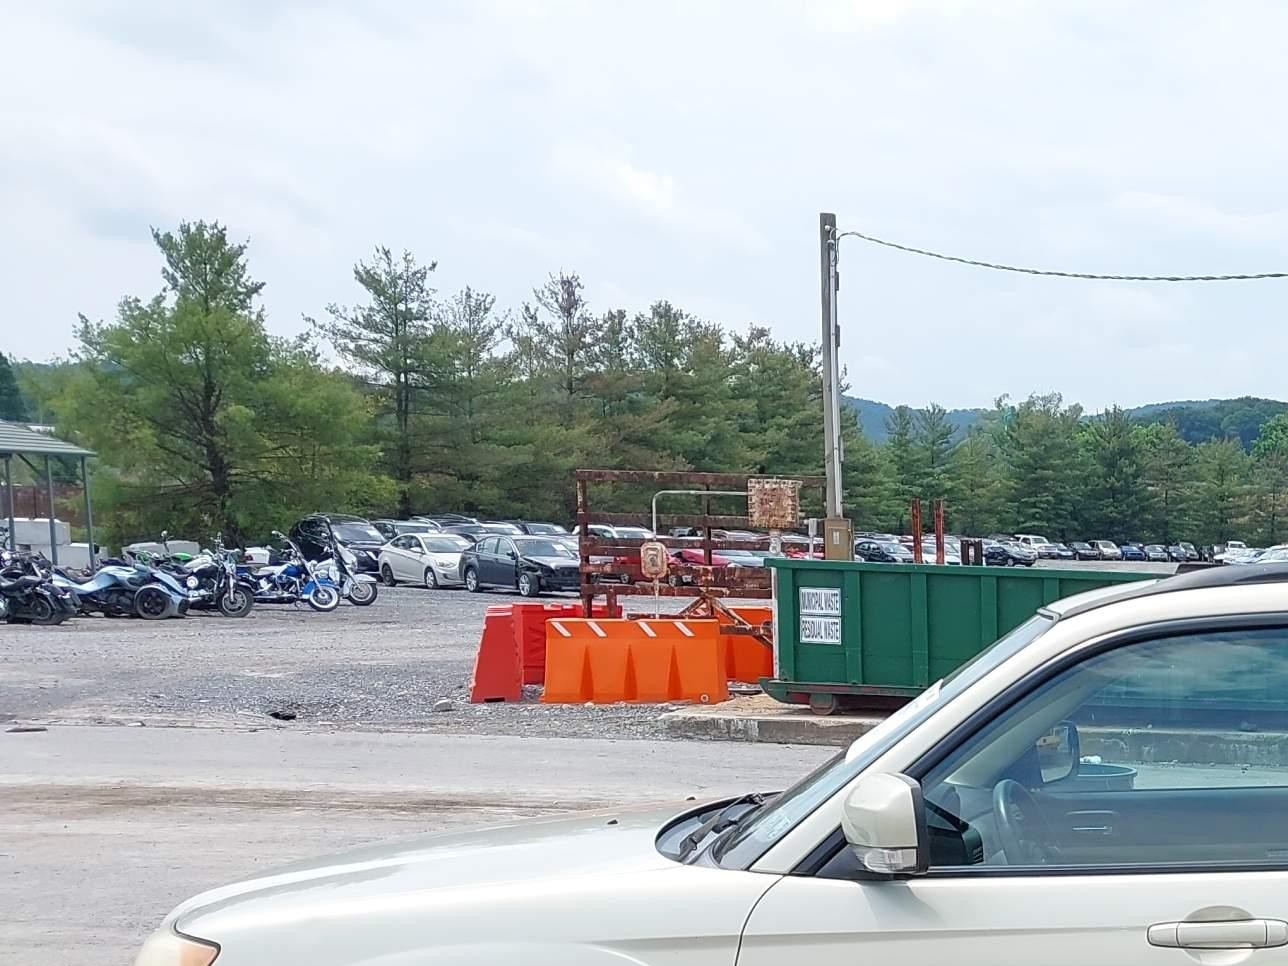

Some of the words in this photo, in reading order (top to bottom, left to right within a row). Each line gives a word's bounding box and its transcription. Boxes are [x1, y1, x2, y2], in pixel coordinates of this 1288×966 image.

[801, 591, 824, 610] MUNICIPAL
[824, 592, 839, 611] WASTE
[801, 620, 823, 639] RESIDUAL
[824, 621, 839, 640] WASTE
